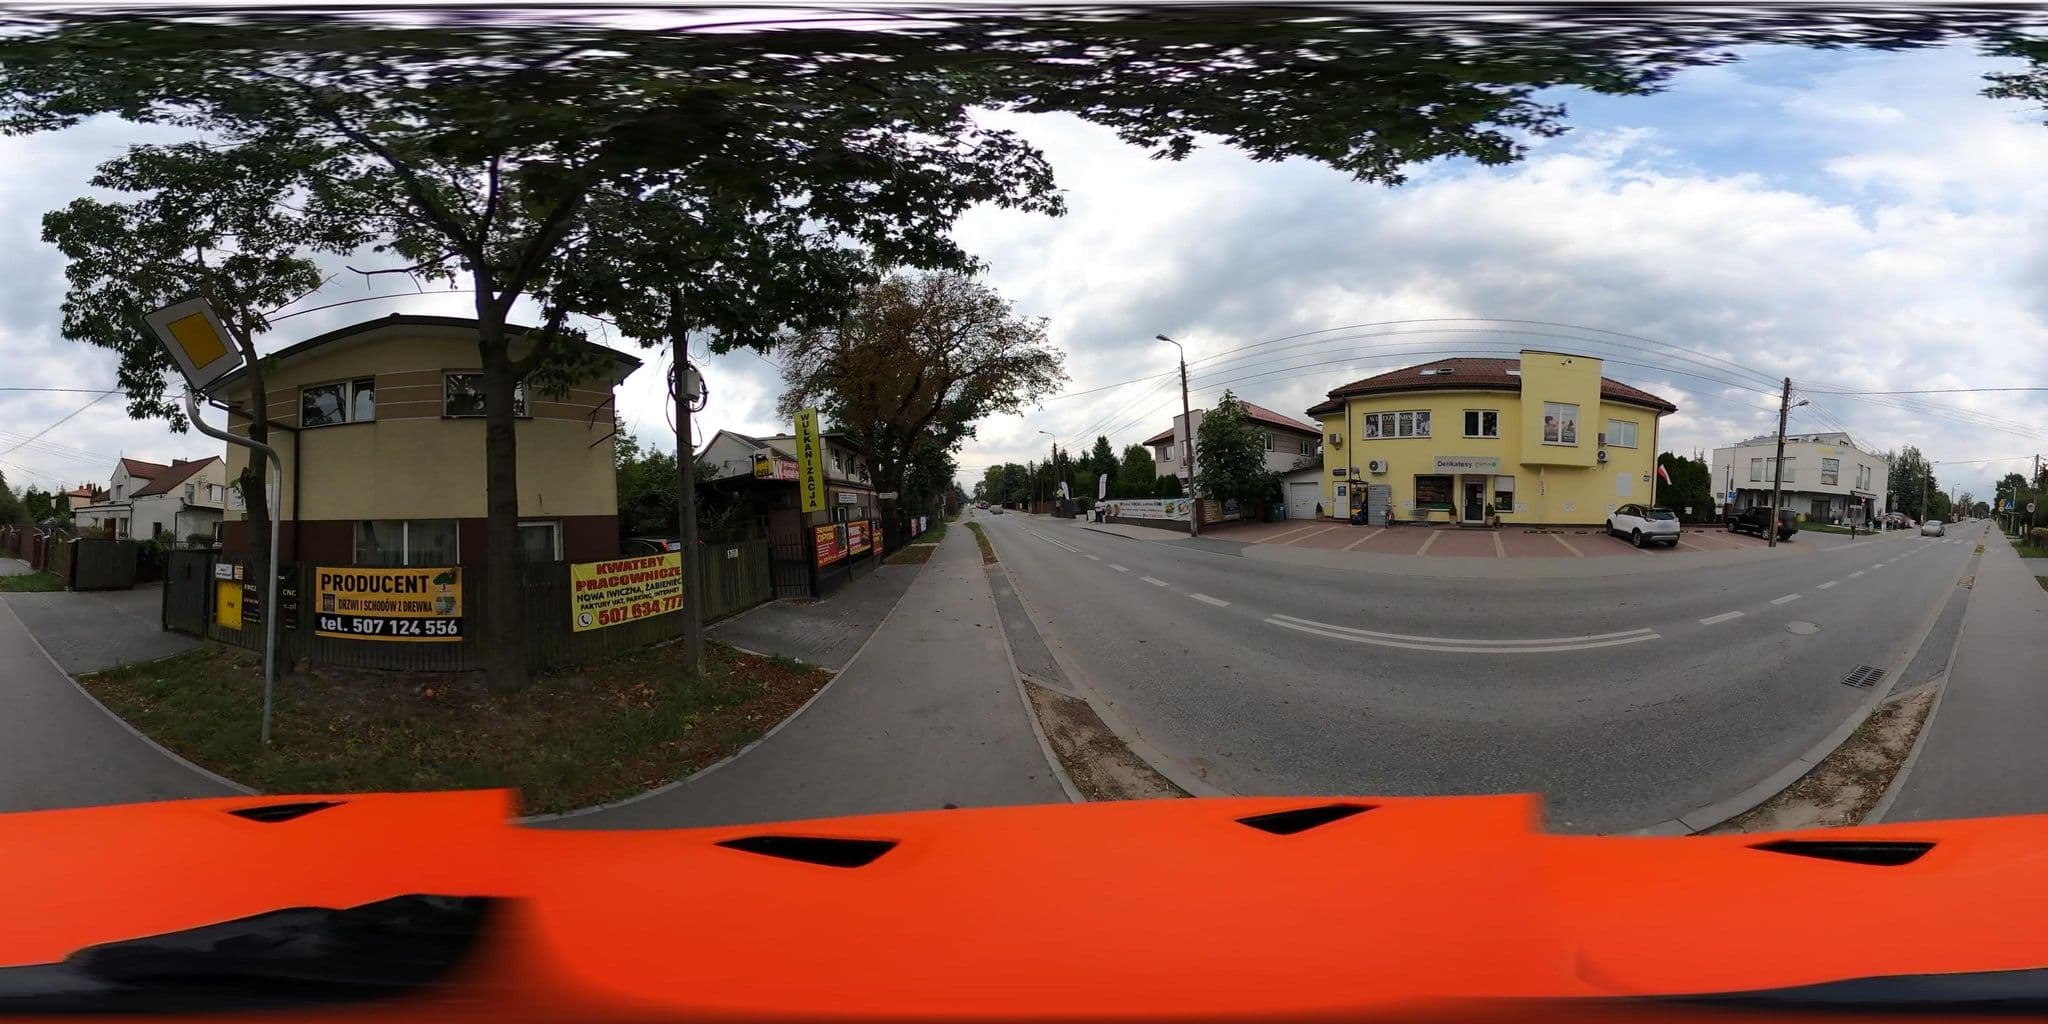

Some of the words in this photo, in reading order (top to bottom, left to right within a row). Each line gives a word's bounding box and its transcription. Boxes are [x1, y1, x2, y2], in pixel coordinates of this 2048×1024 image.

[800, 413, 817, 508] WULKANIZACJA
[1437, 460, 1473, 469] Delikatesy
[596, 556, 665, 575] KWATERY
[320, 573, 430, 593] PRODUCENT
[575, 566, 681, 592] PRACOWNICZE
[577, 592, 605, 603] NOWA
[606, 586, 644, 598] IWICZNA,
[645, 578, 682, 592] ŻABIENIEC
[580, 600, 611, 611] FAKTURY
[612, 598, 626, 606] VAT,
[626, 592, 654, 604] PARKING,
[654, 587, 680, 598] INTERNET
[338, 599, 360, 611] DRZWI
[363, 598, 399, 612] SCHODÓW
[403, 601, 433, 613] DREWNA
[598, 606, 628, 625] 507
[631, 599, 661, 618] 634
[663, 594, 684, 609] 777
[320, 616, 348, 632] tel.
[353, 618, 384, 634] 507
[390, 619, 421, 635] 124
[425, 620, 457, 635] 556
